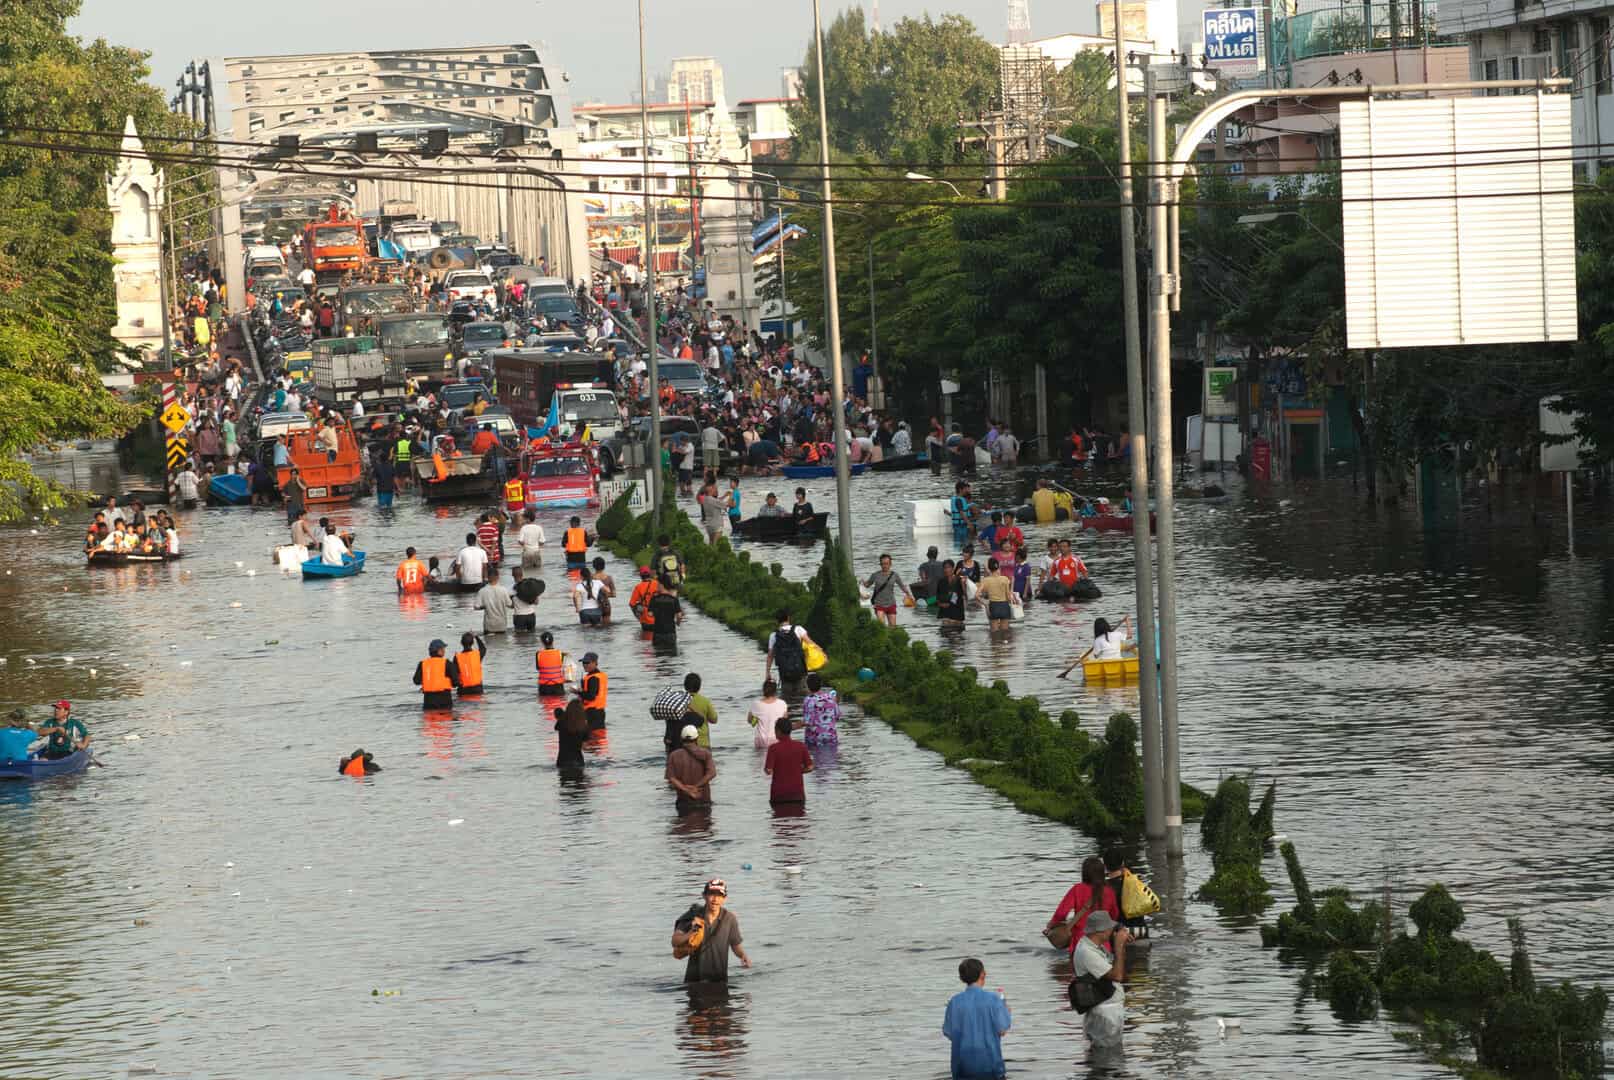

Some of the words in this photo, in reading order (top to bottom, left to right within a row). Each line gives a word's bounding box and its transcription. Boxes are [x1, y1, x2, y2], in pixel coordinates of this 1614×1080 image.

[1206, 12, 1254, 35] คลีนิค
[1208, 34, 1255, 58] ฟันดี
[579, 393, 597, 402] 033
